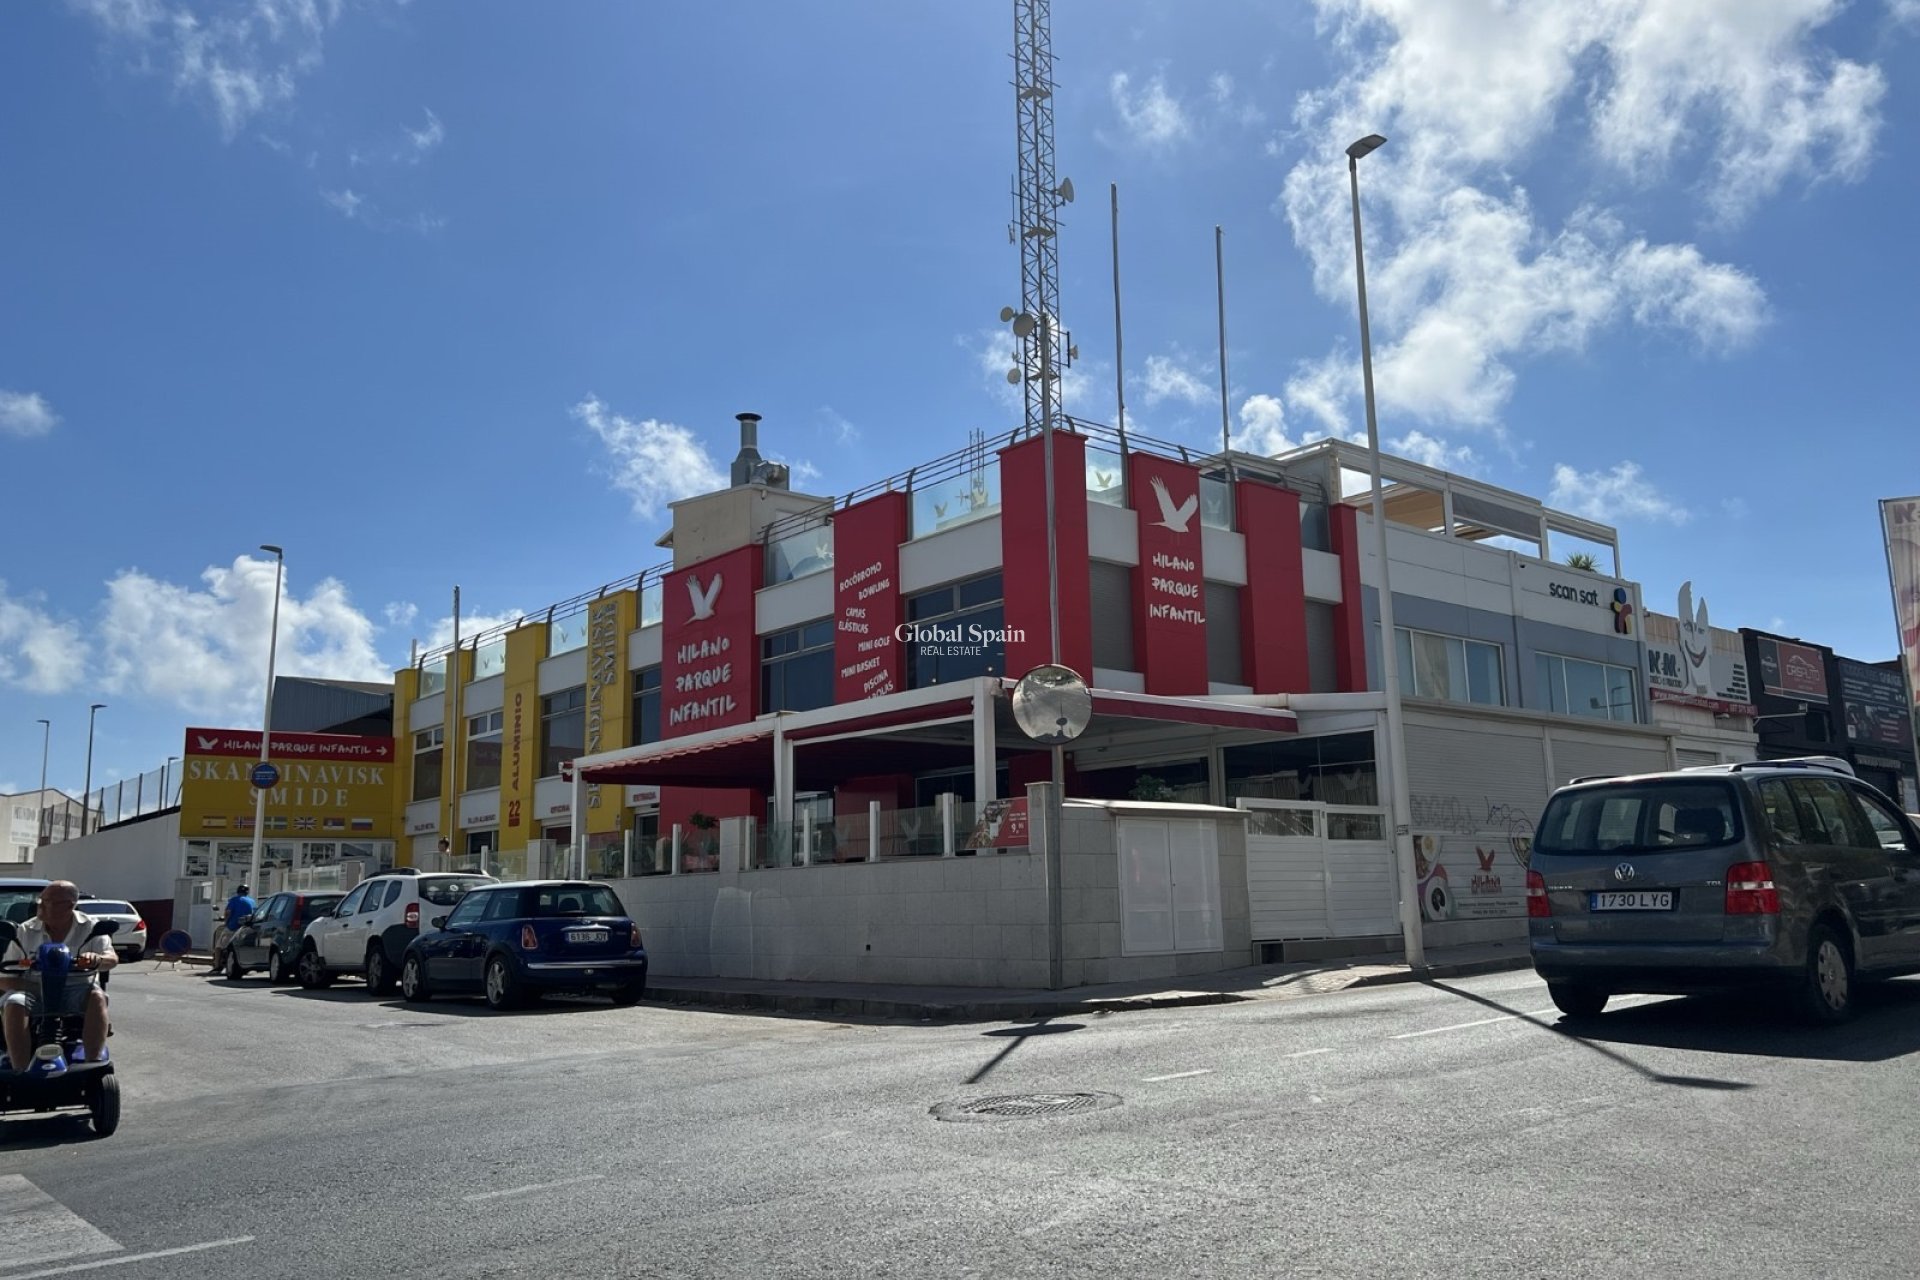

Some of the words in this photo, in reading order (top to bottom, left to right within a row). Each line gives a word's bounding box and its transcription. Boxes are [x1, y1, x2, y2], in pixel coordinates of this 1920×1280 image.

[1152, 552, 1195, 572] HILANO
[839, 561, 882, 592] ROCÓDROMO
[1151, 577, 1199, 598] PARQUE
[858, 578, 890, 600] BOWLING
[1549, 582, 1578, 601] scan
[1580, 590, 1599, 606] sat
[846, 607, 866, 618] CAMAS
[1150, 603, 1206, 625] INFANTIL
[677, 636, 730, 664] HILANO
[874, 636, 890, 648] GOLF
[676, 663, 731, 693] PARQUE
[864, 669, 888, 693] PISCINA
[670, 695, 736, 727] INFANTIL
[223, 738, 264, 750] HILAN
[269, 742, 315, 753] PARQUE
[319, 743, 372, 755] INFANTIL
[512, 692, 522, 791] ALUMINIO
[249, 787, 349, 807] SMIDE
[508, 800, 520, 817] 22
[1601, 894, 1636, 908] 1730
[1639, 894, 1670, 908] LYG
